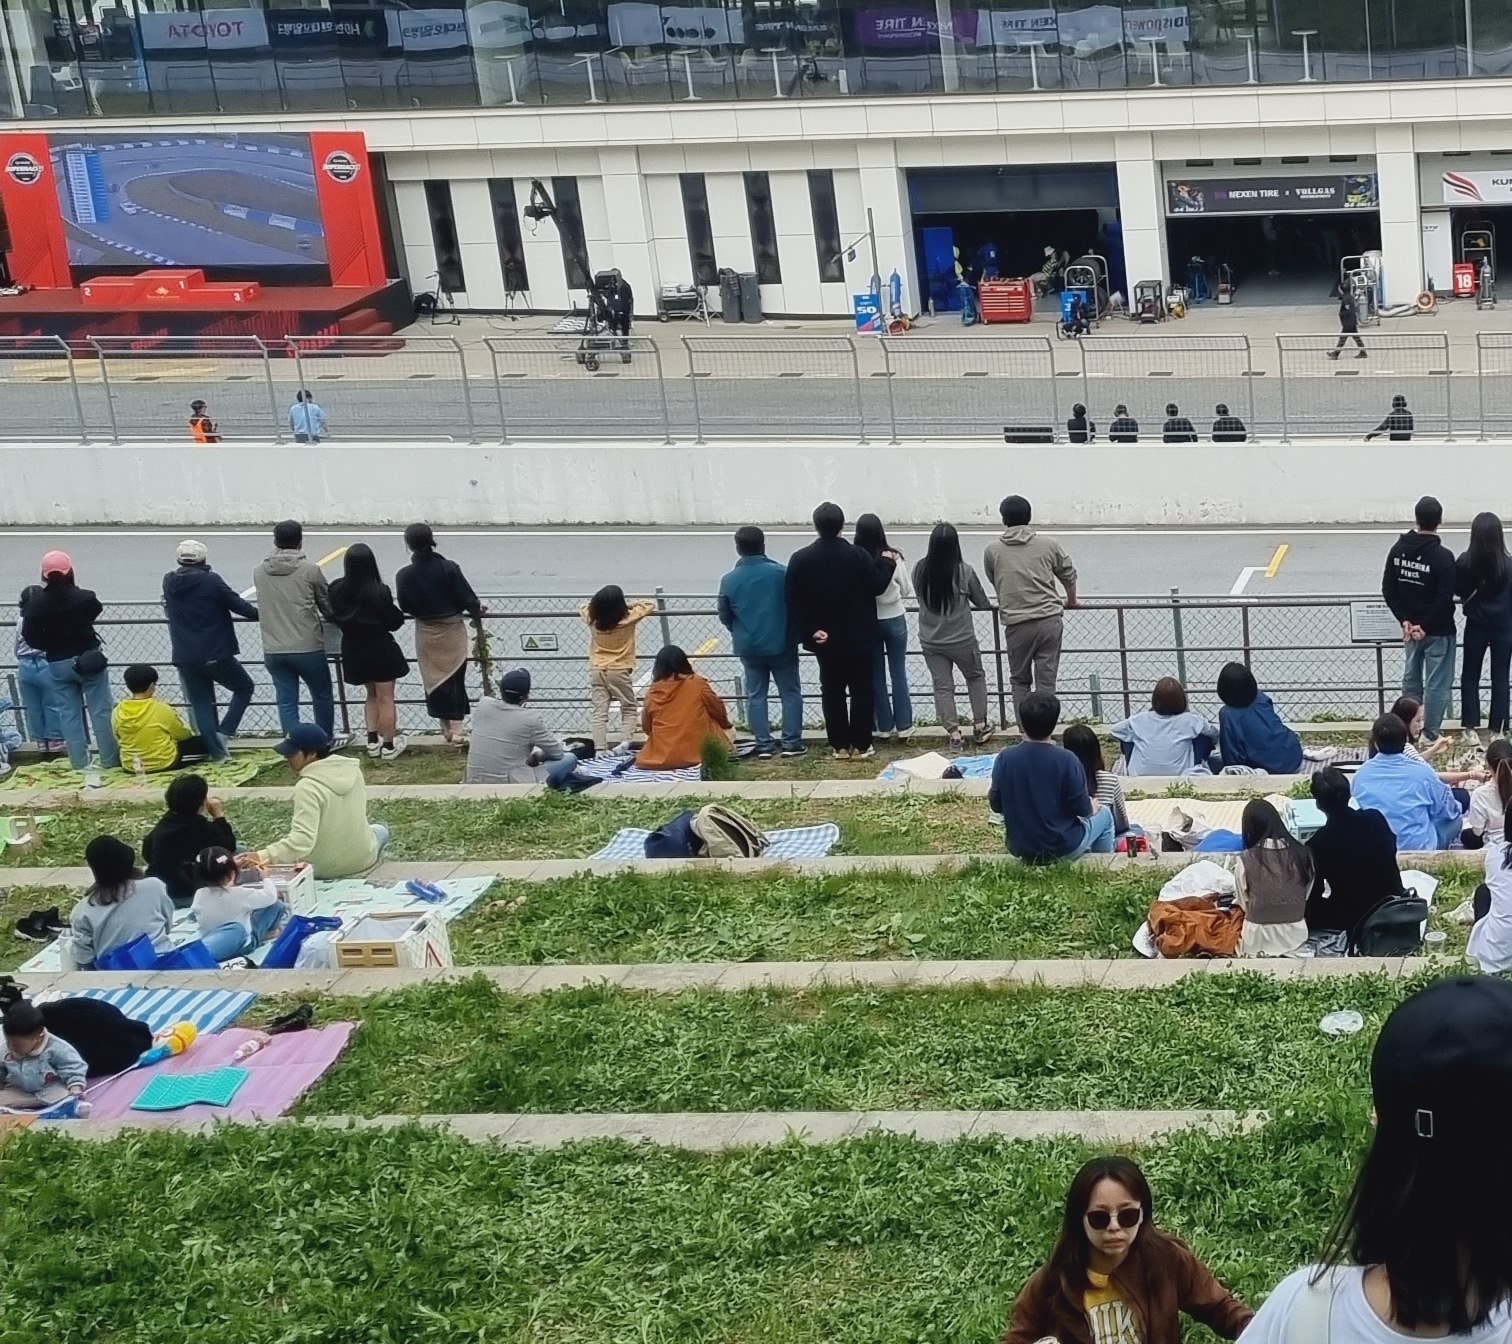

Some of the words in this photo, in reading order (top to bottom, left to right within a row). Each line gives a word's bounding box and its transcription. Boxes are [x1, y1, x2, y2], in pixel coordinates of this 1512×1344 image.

[1228, 190, 1258, 200] NEXEN
[1259, 189, 1280, 199] TIRE
[1295, 187, 1336, 197] VOLLGAS
[1455, 273, 1472, 289] 18
[84, 286, 92, 297] 2
[233, 292, 241, 302] 3
